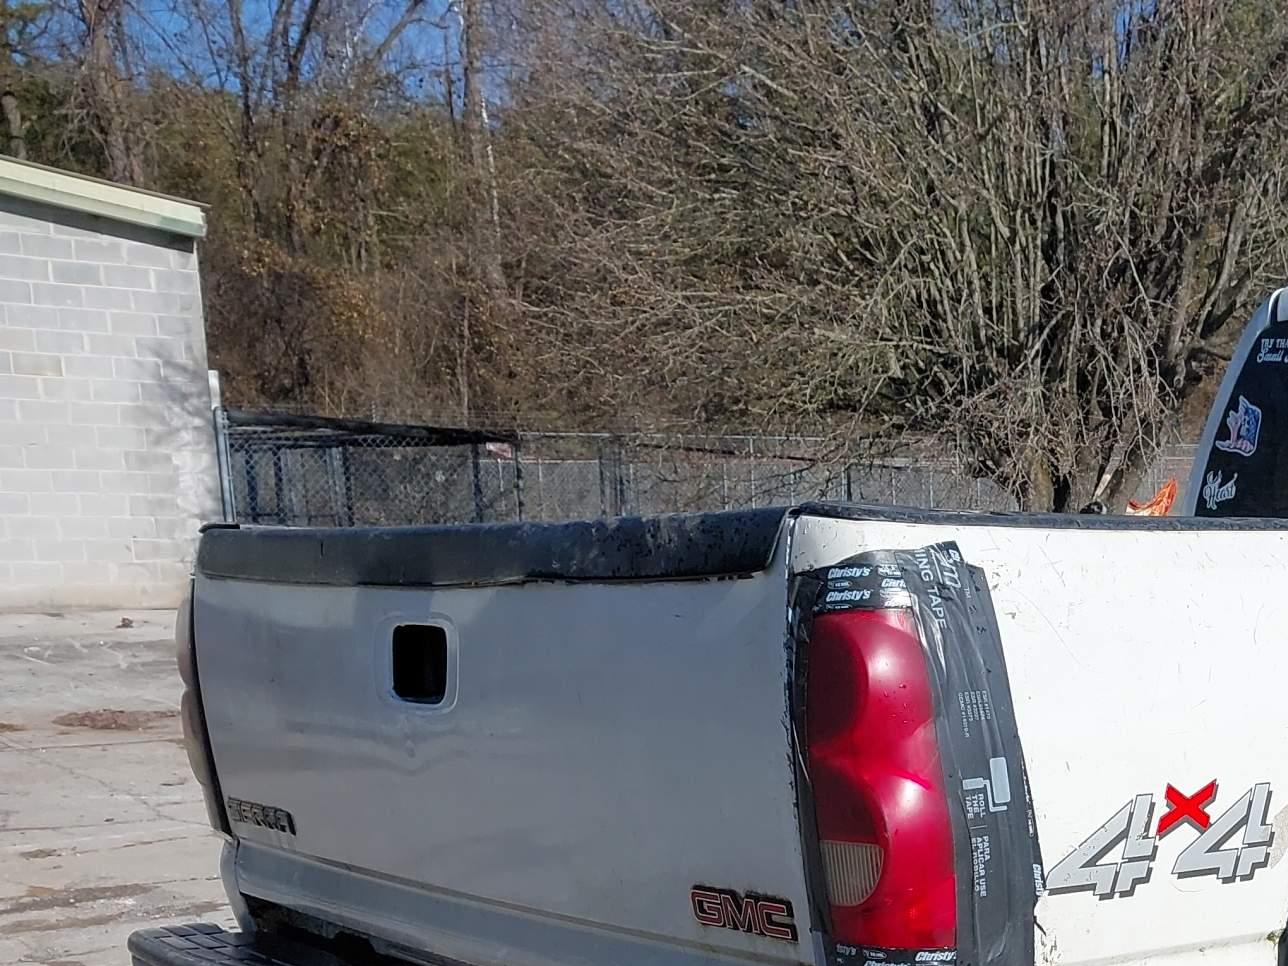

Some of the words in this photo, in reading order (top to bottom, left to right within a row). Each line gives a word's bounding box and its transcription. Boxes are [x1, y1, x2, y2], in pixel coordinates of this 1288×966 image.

[827, 566, 871, 579] Christy's
[826, 589, 871, 602] Christy's
[927, 585, 947, 630] TAPE
[965, 795, 974, 820] TAPE
[972, 794, 980, 813] THE
[977, 793, 987, 818] ROLL
[976, 837, 985, 876] APLICAR
[982, 836, 991, 861] PARA
[979, 878, 987, 897] USE
[690, 886, 797, 941] GMC
